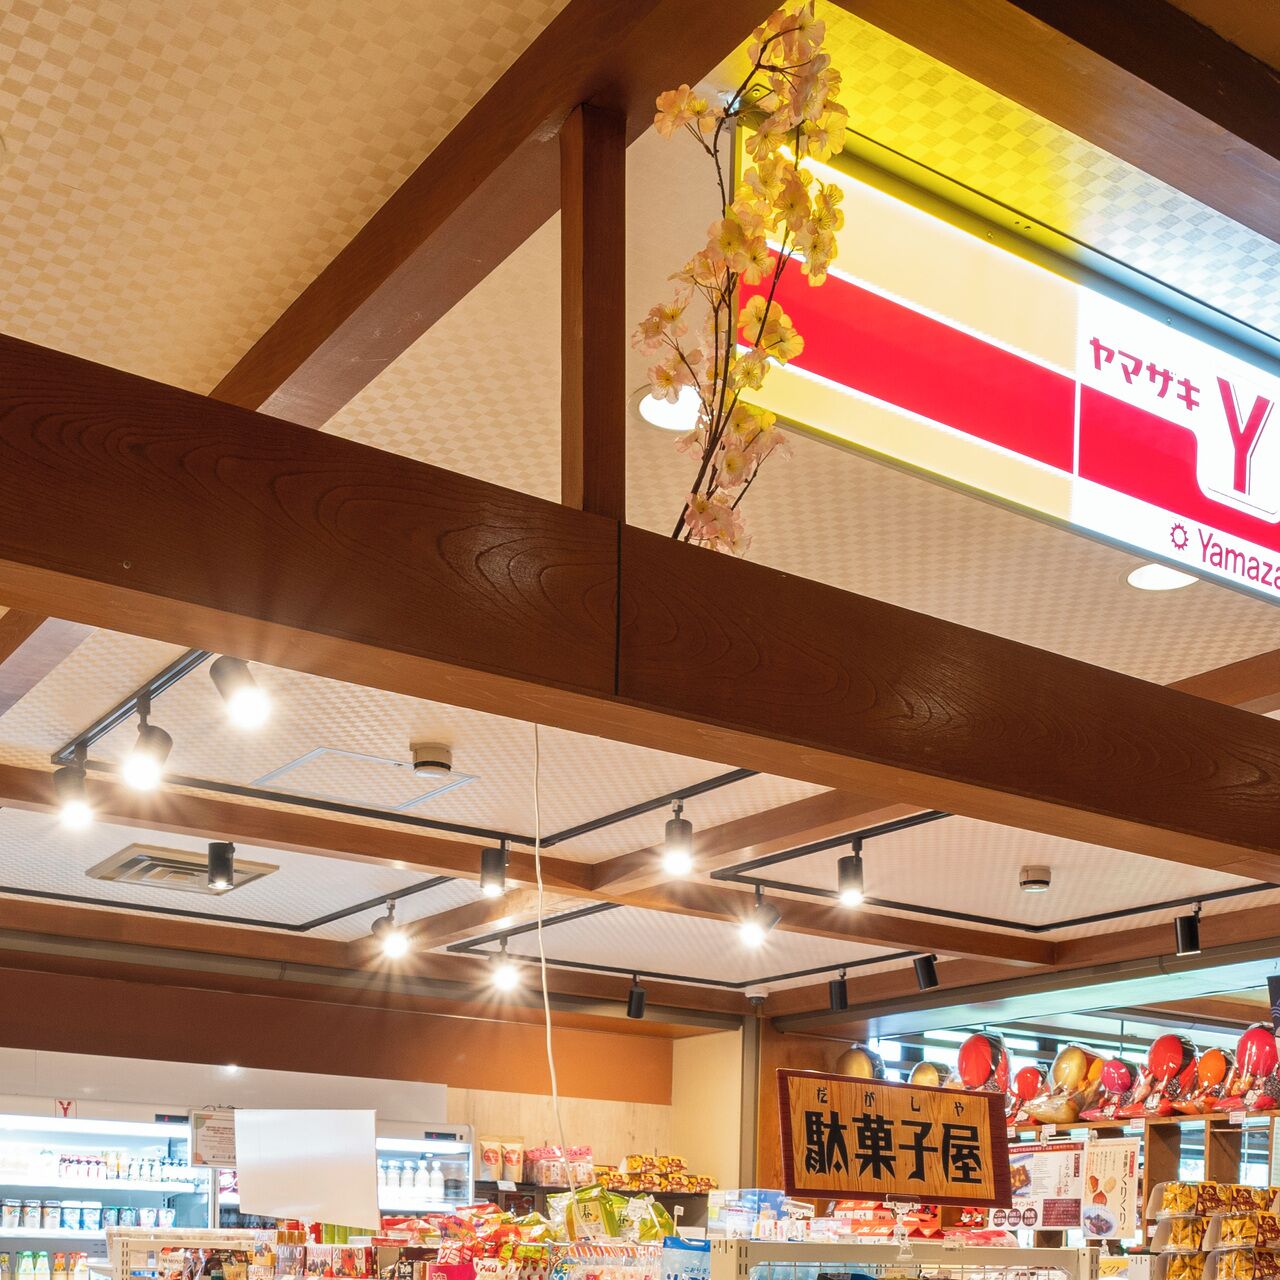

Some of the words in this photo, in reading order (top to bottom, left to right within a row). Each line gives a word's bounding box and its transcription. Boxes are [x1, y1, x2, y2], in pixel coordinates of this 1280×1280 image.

[1089, 337, 1201, 412] ヤマザキ
[1214, 374, 1276, 496] Y
[58, 1101, 71, 1118] Y
[805, 1110, 983, 1185] 駄菓子屋
